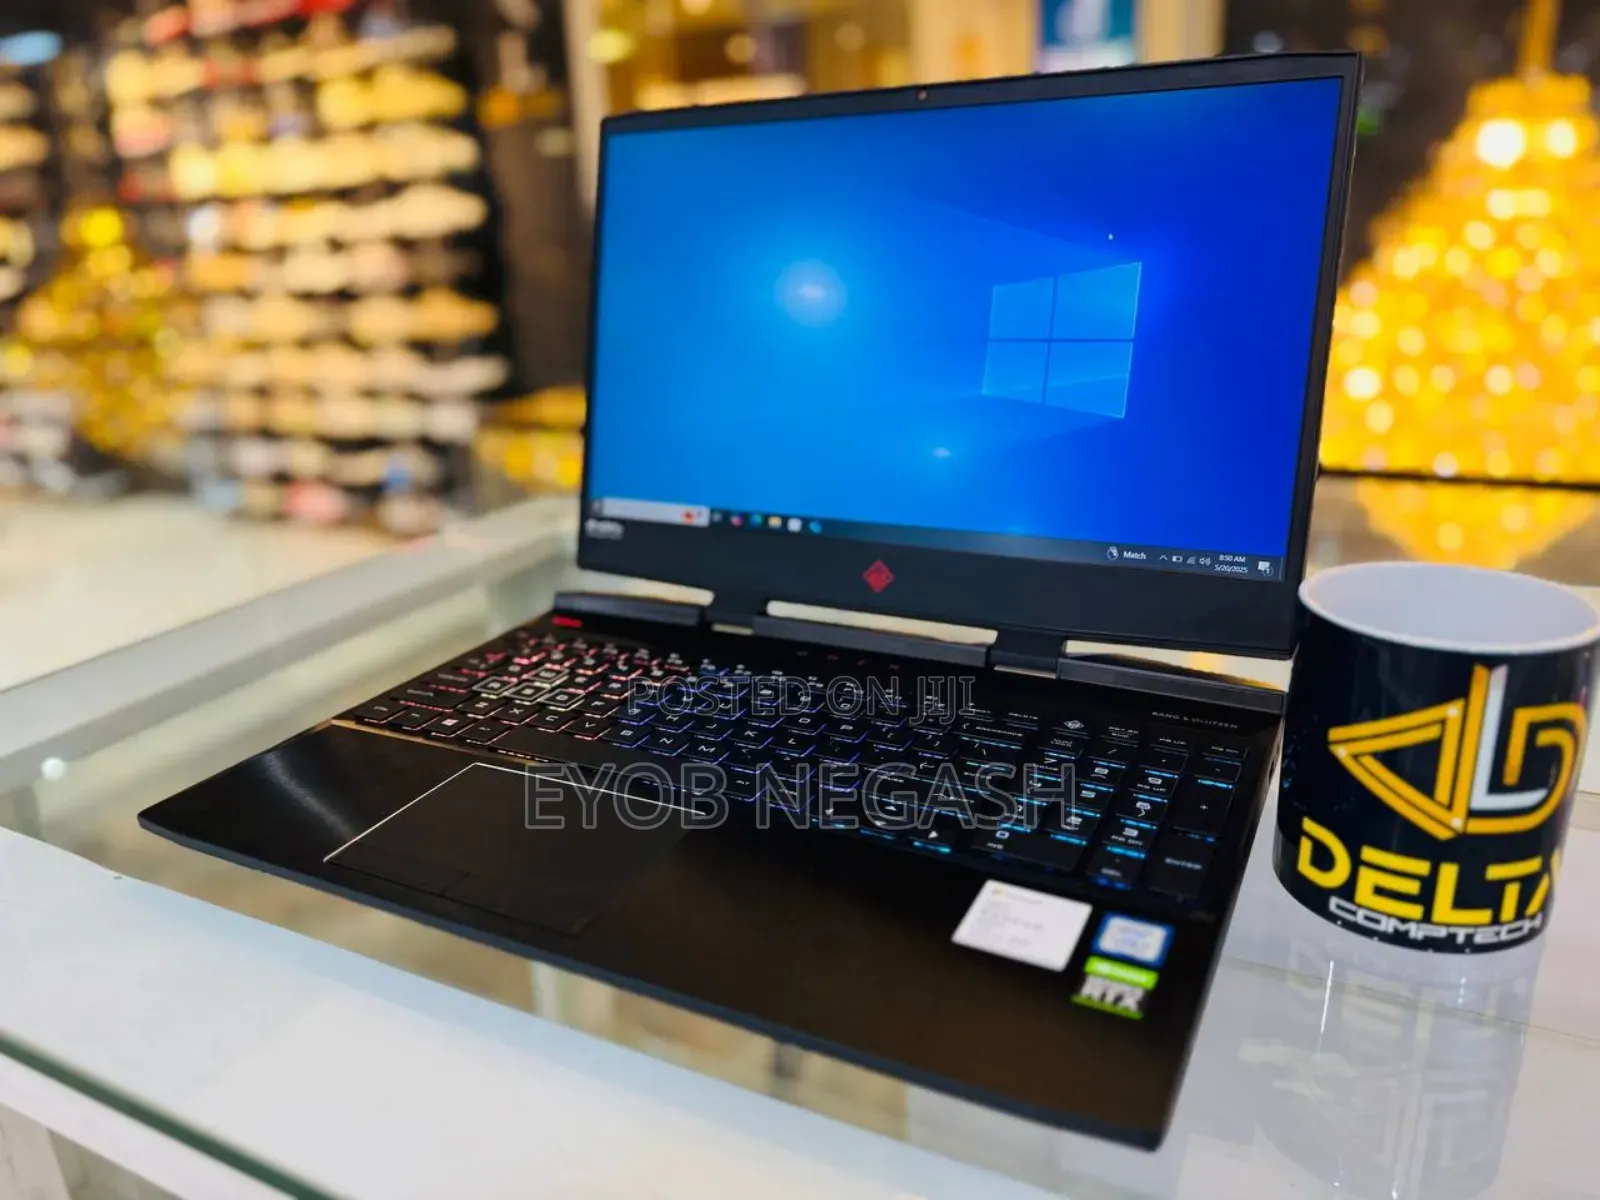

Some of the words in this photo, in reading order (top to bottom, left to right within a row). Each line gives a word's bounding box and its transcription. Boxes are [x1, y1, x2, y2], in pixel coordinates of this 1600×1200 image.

[1123, 550, 1147, 560] Match
[1233, 555, 1246, 563] AM
[1214, 564, 1249, 574] 5/20/2025
[1328, 895, 1543, 944] COMPTECH
